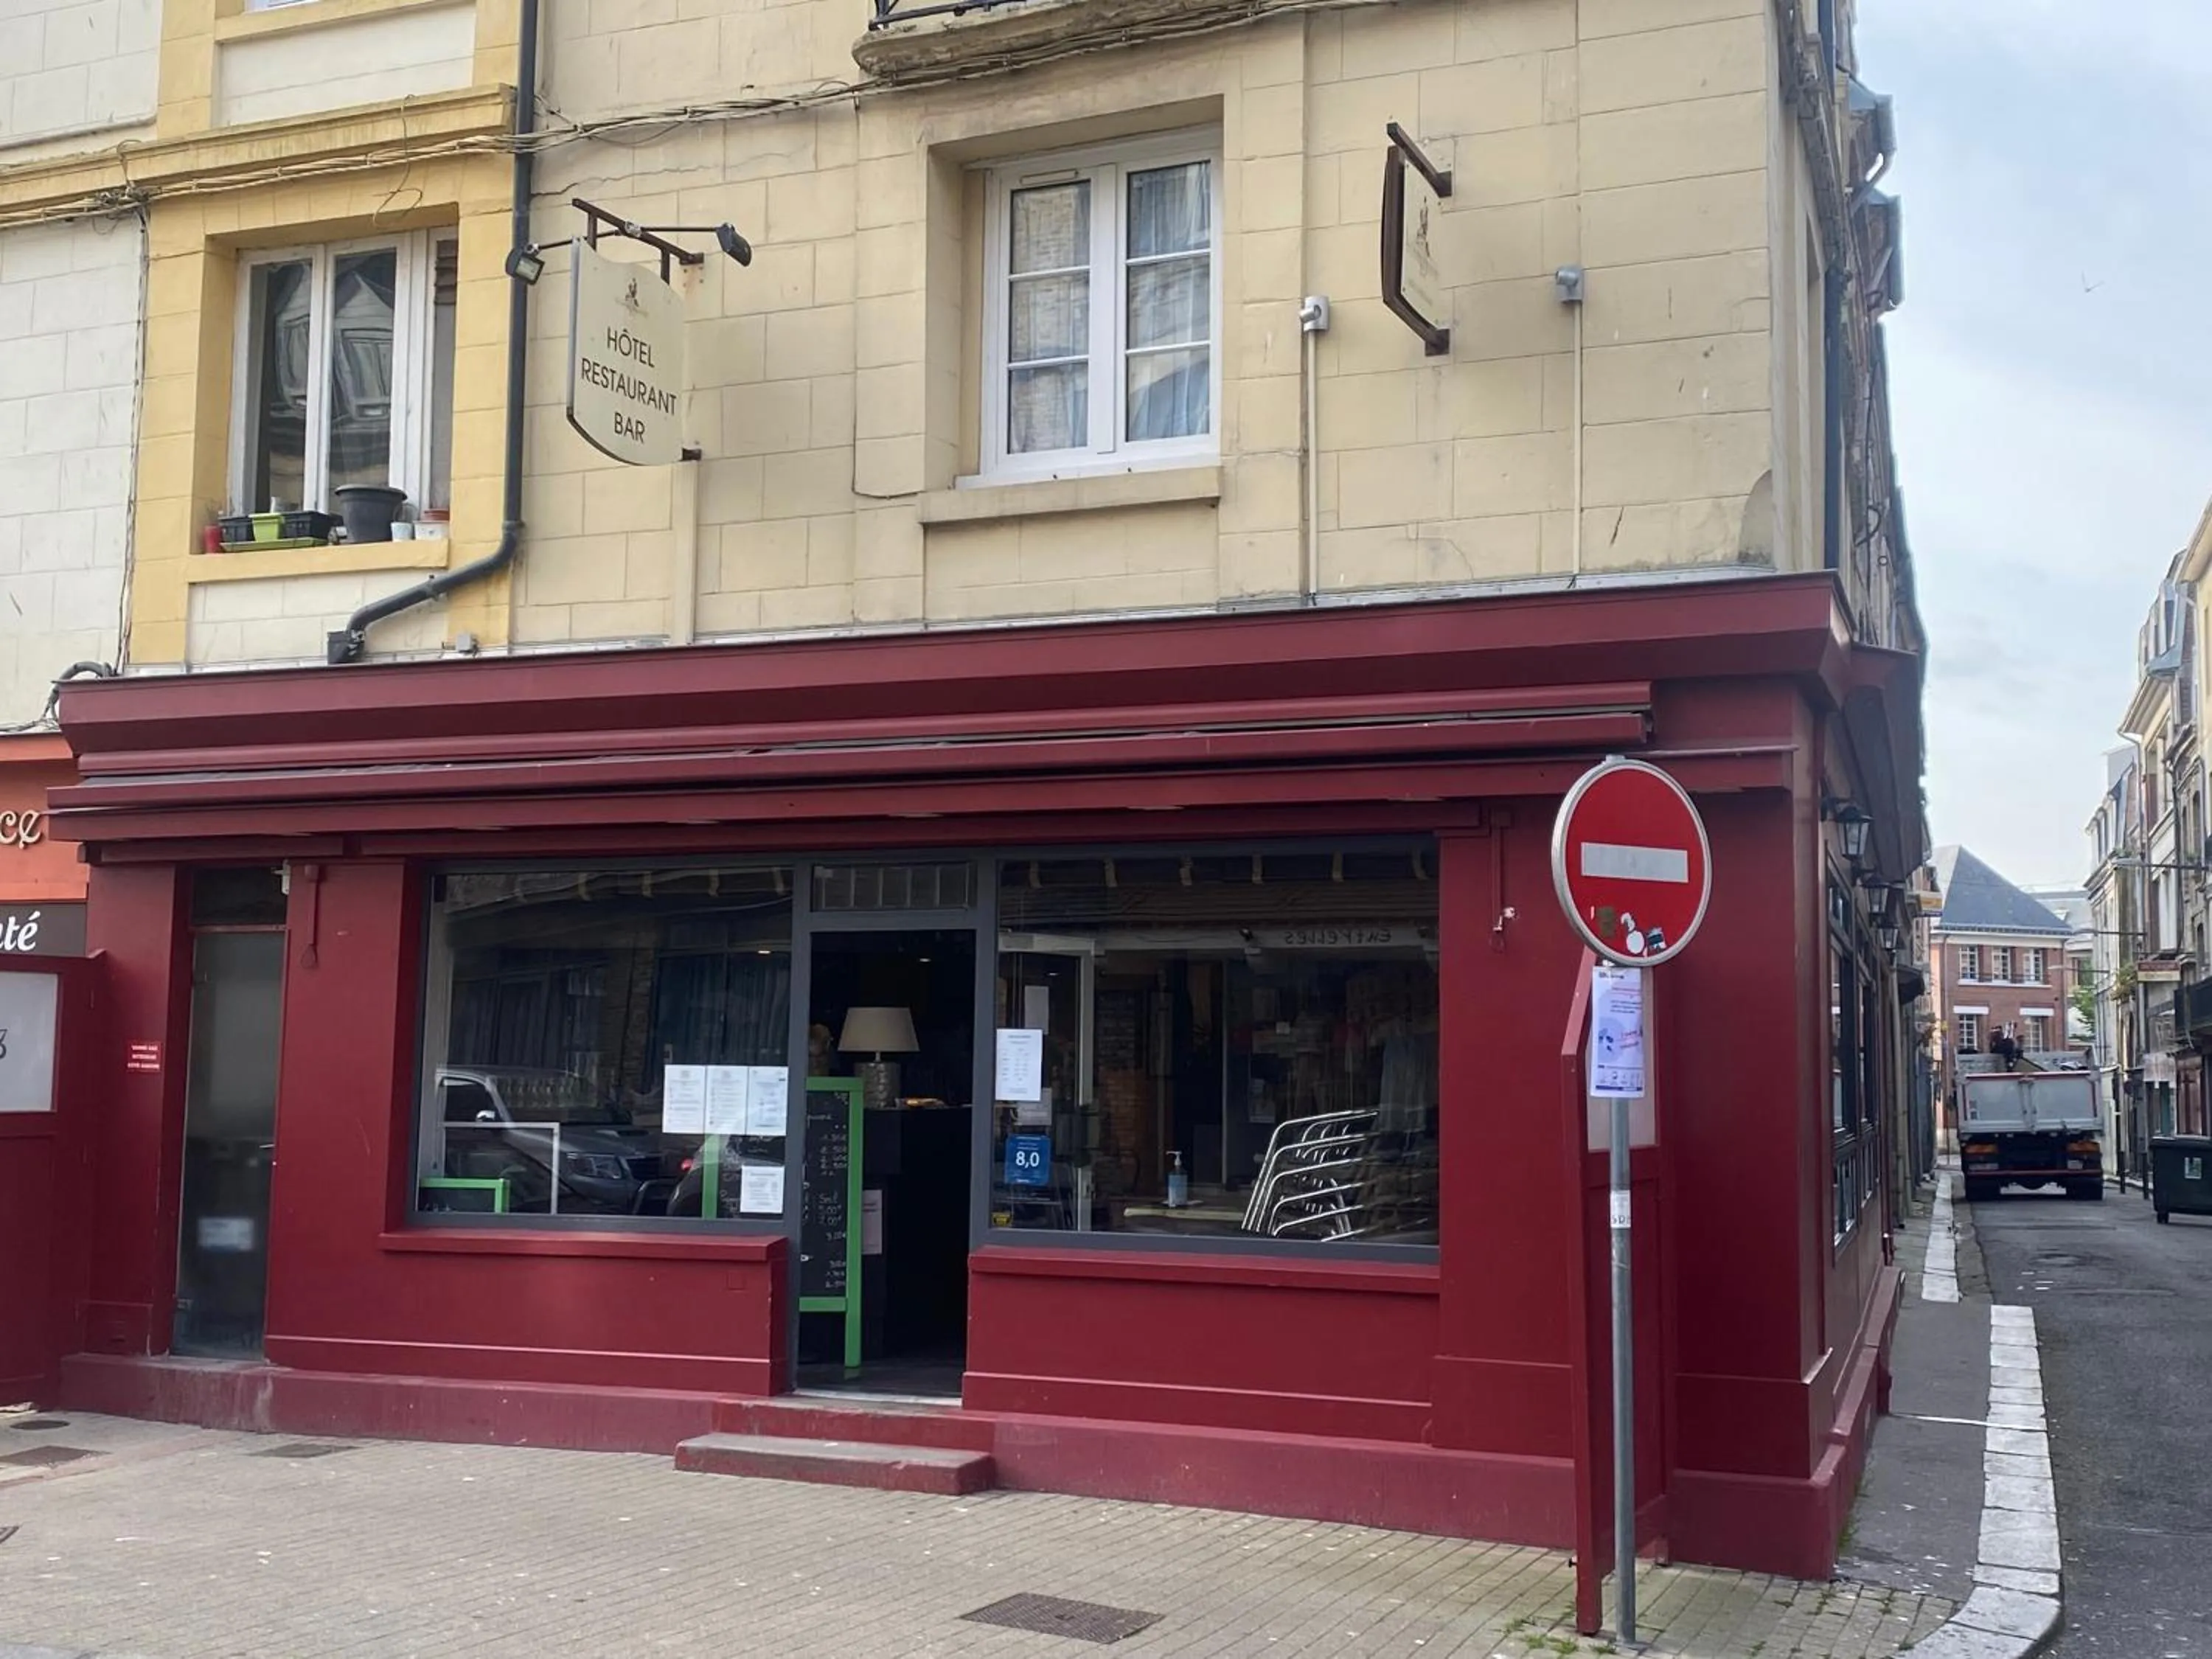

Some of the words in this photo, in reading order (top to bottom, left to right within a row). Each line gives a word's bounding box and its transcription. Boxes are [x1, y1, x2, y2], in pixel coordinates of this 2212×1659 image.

[607, 326, 655, 368] HÔTEL
[581, 358, 677, 416] RESTAURANT
[614, 411, 645, 443] BAR
[0, 911, 41, 950] té
[1015, 1151, 1040, 1169] 8,0
